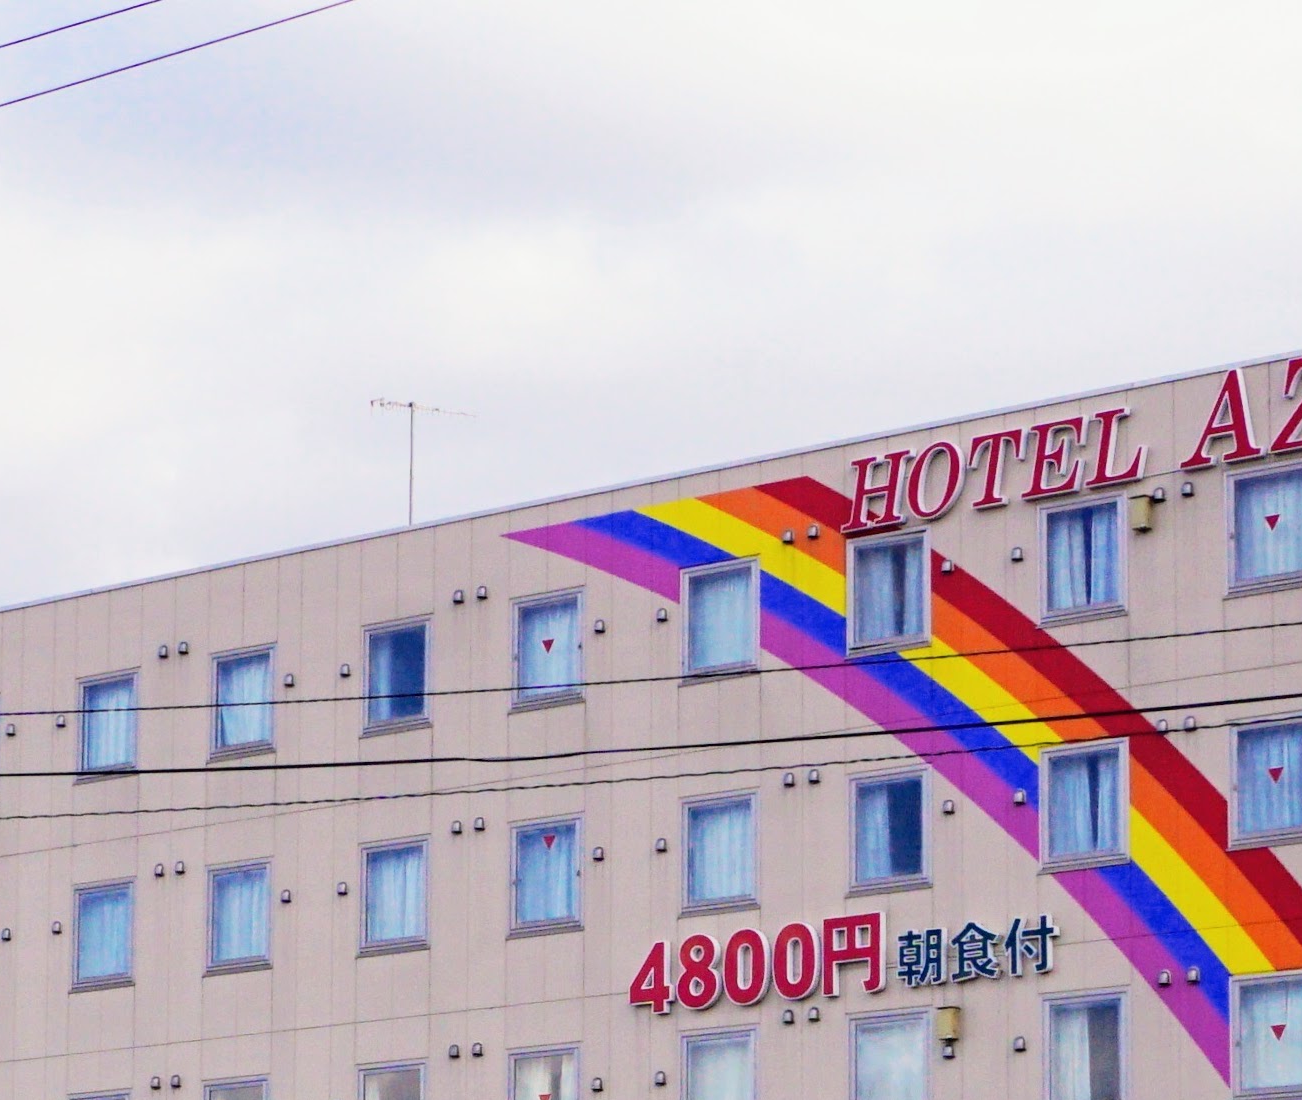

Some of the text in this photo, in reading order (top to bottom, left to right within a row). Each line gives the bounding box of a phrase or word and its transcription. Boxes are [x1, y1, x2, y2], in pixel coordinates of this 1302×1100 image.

[841, 406, 1149, 534] HOTEL
[629, 911, 1060, 1015] 4800円 朝食付
